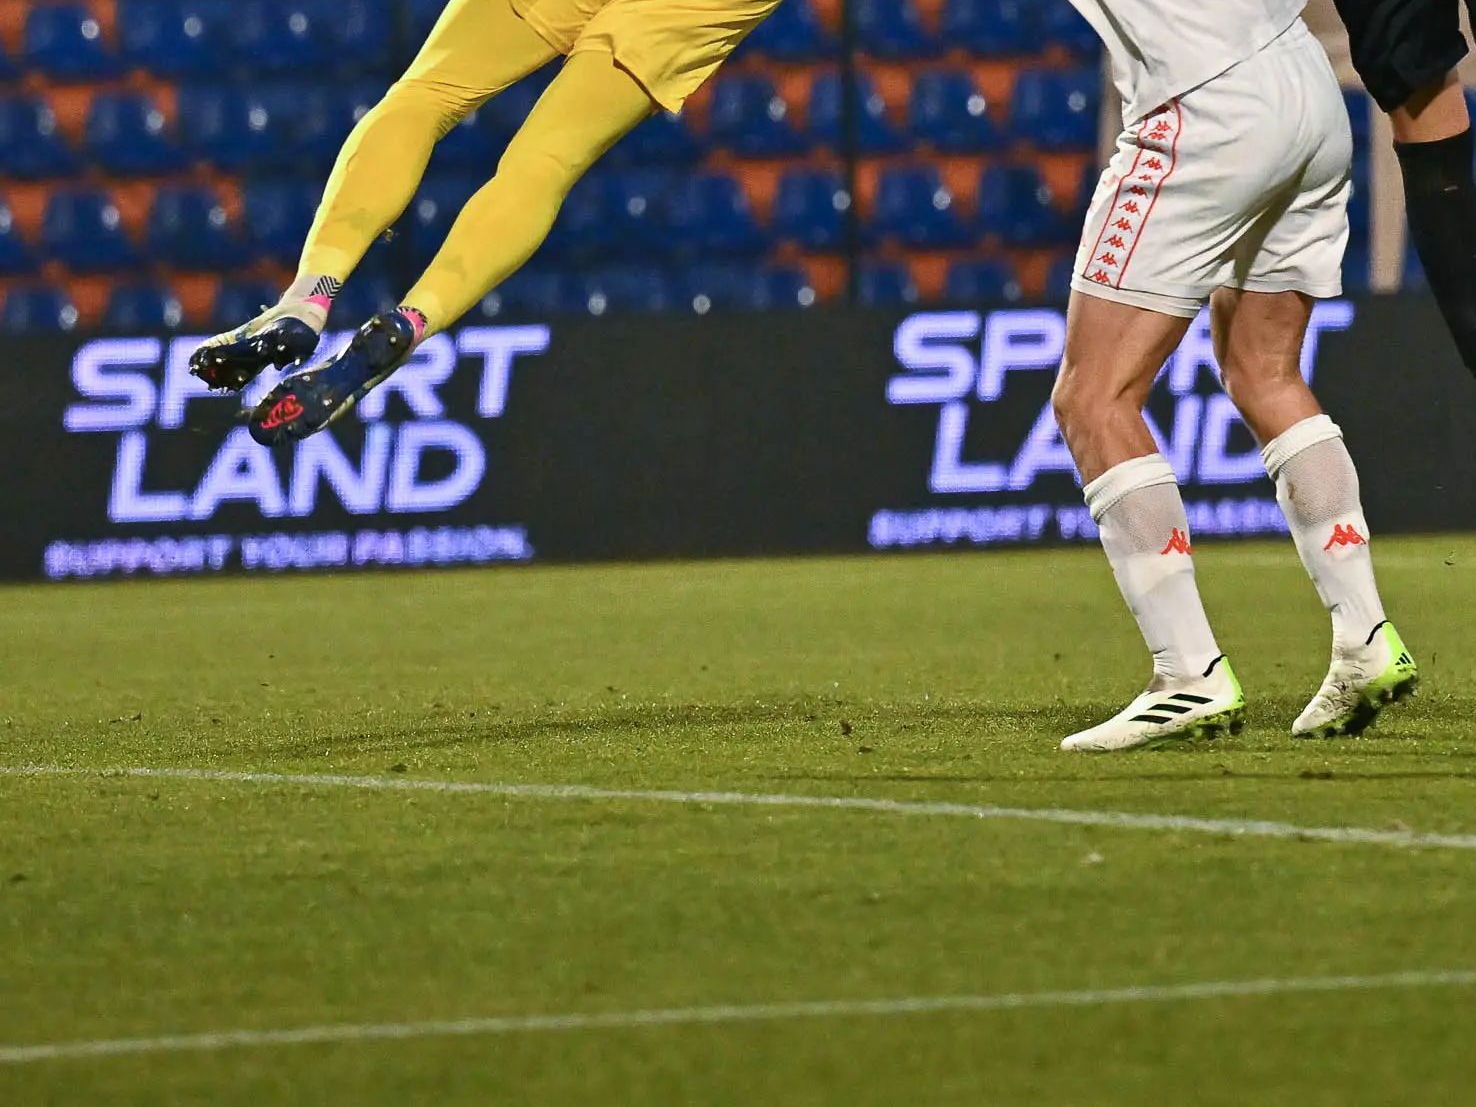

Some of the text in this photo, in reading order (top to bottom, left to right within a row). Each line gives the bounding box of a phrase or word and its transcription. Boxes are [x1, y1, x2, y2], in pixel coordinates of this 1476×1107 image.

[106, 420, 487, 524] LAND
[44, 534, 232, 579] SUPPORT
[241, 530, 349, 569] YOUR
